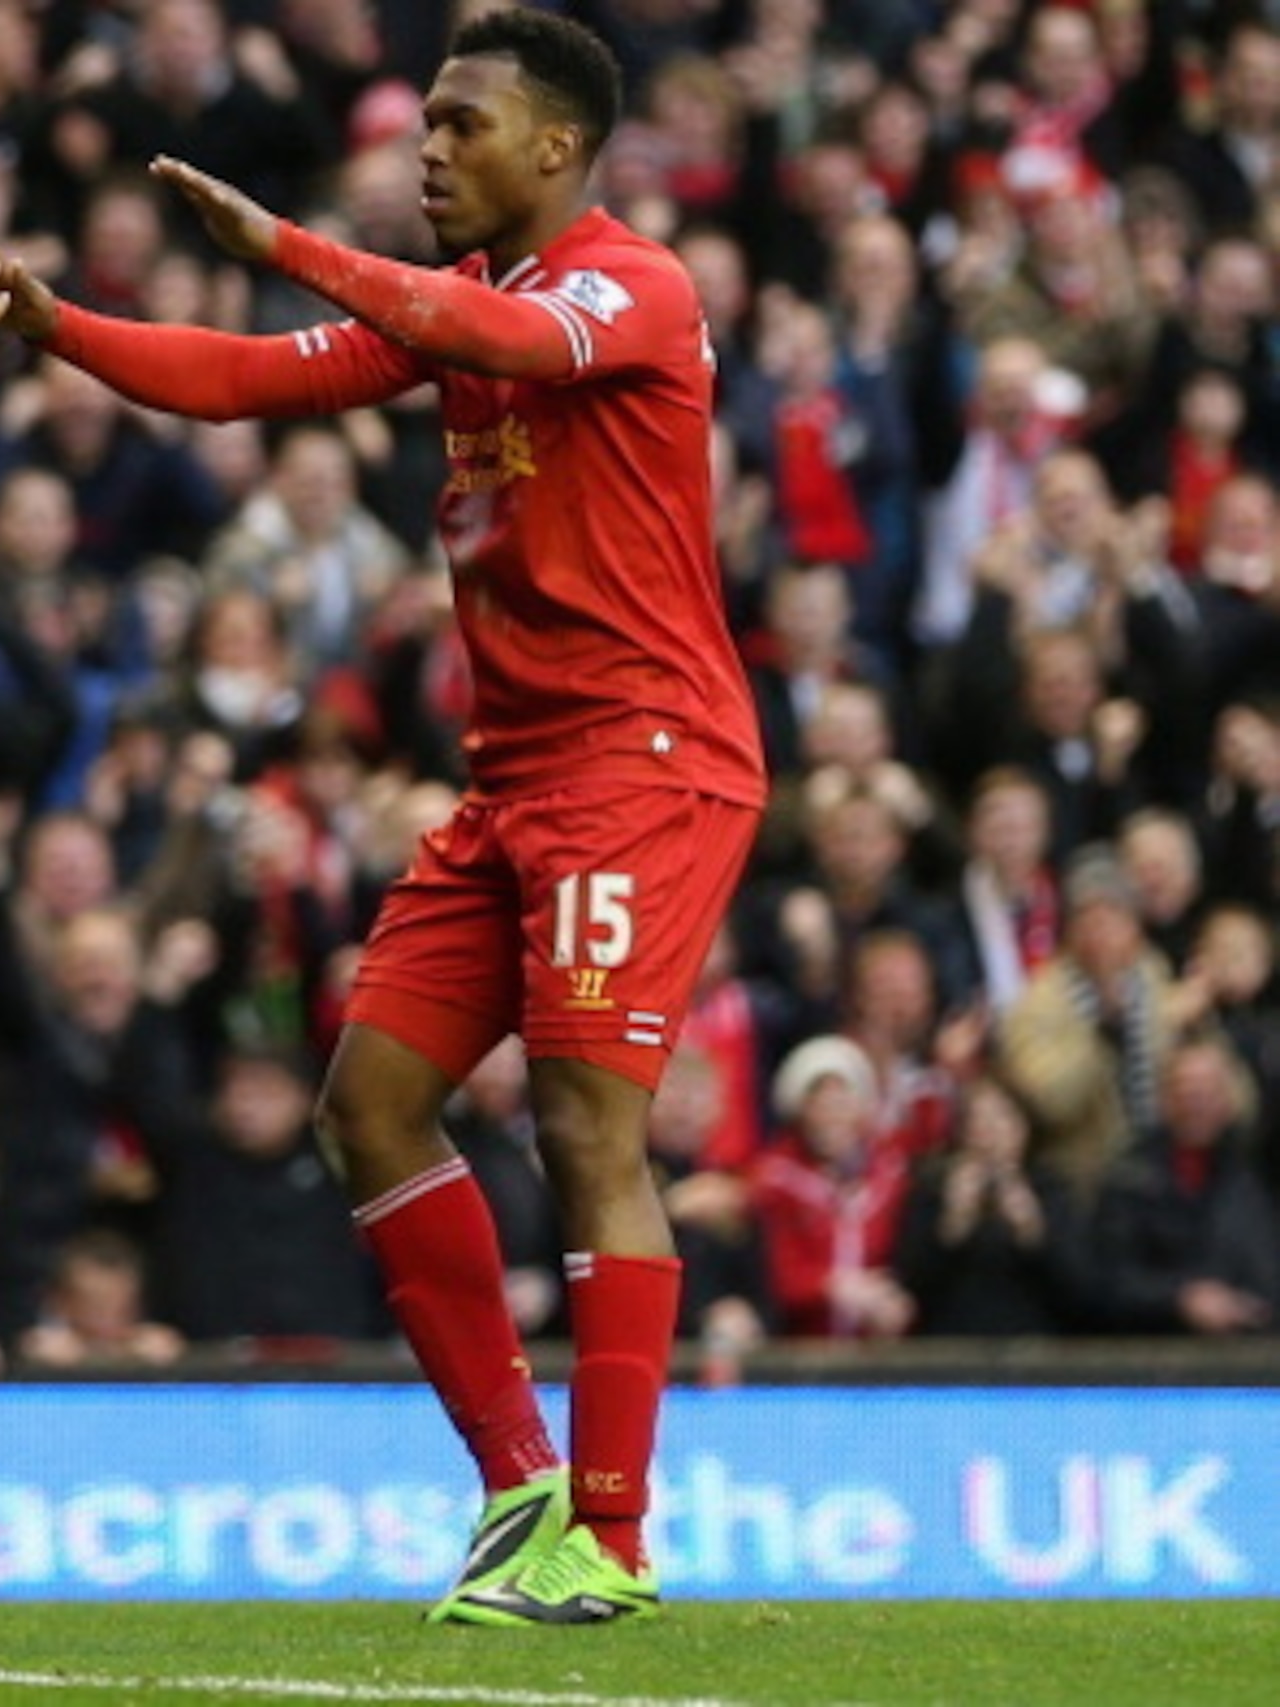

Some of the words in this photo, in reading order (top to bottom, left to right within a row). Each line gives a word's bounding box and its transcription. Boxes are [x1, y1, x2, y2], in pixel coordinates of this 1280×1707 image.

[551, 871, 635, 967] 15
[652, 1453, 912, 1584] the
[961, 1453, 1250, 1586] UK
